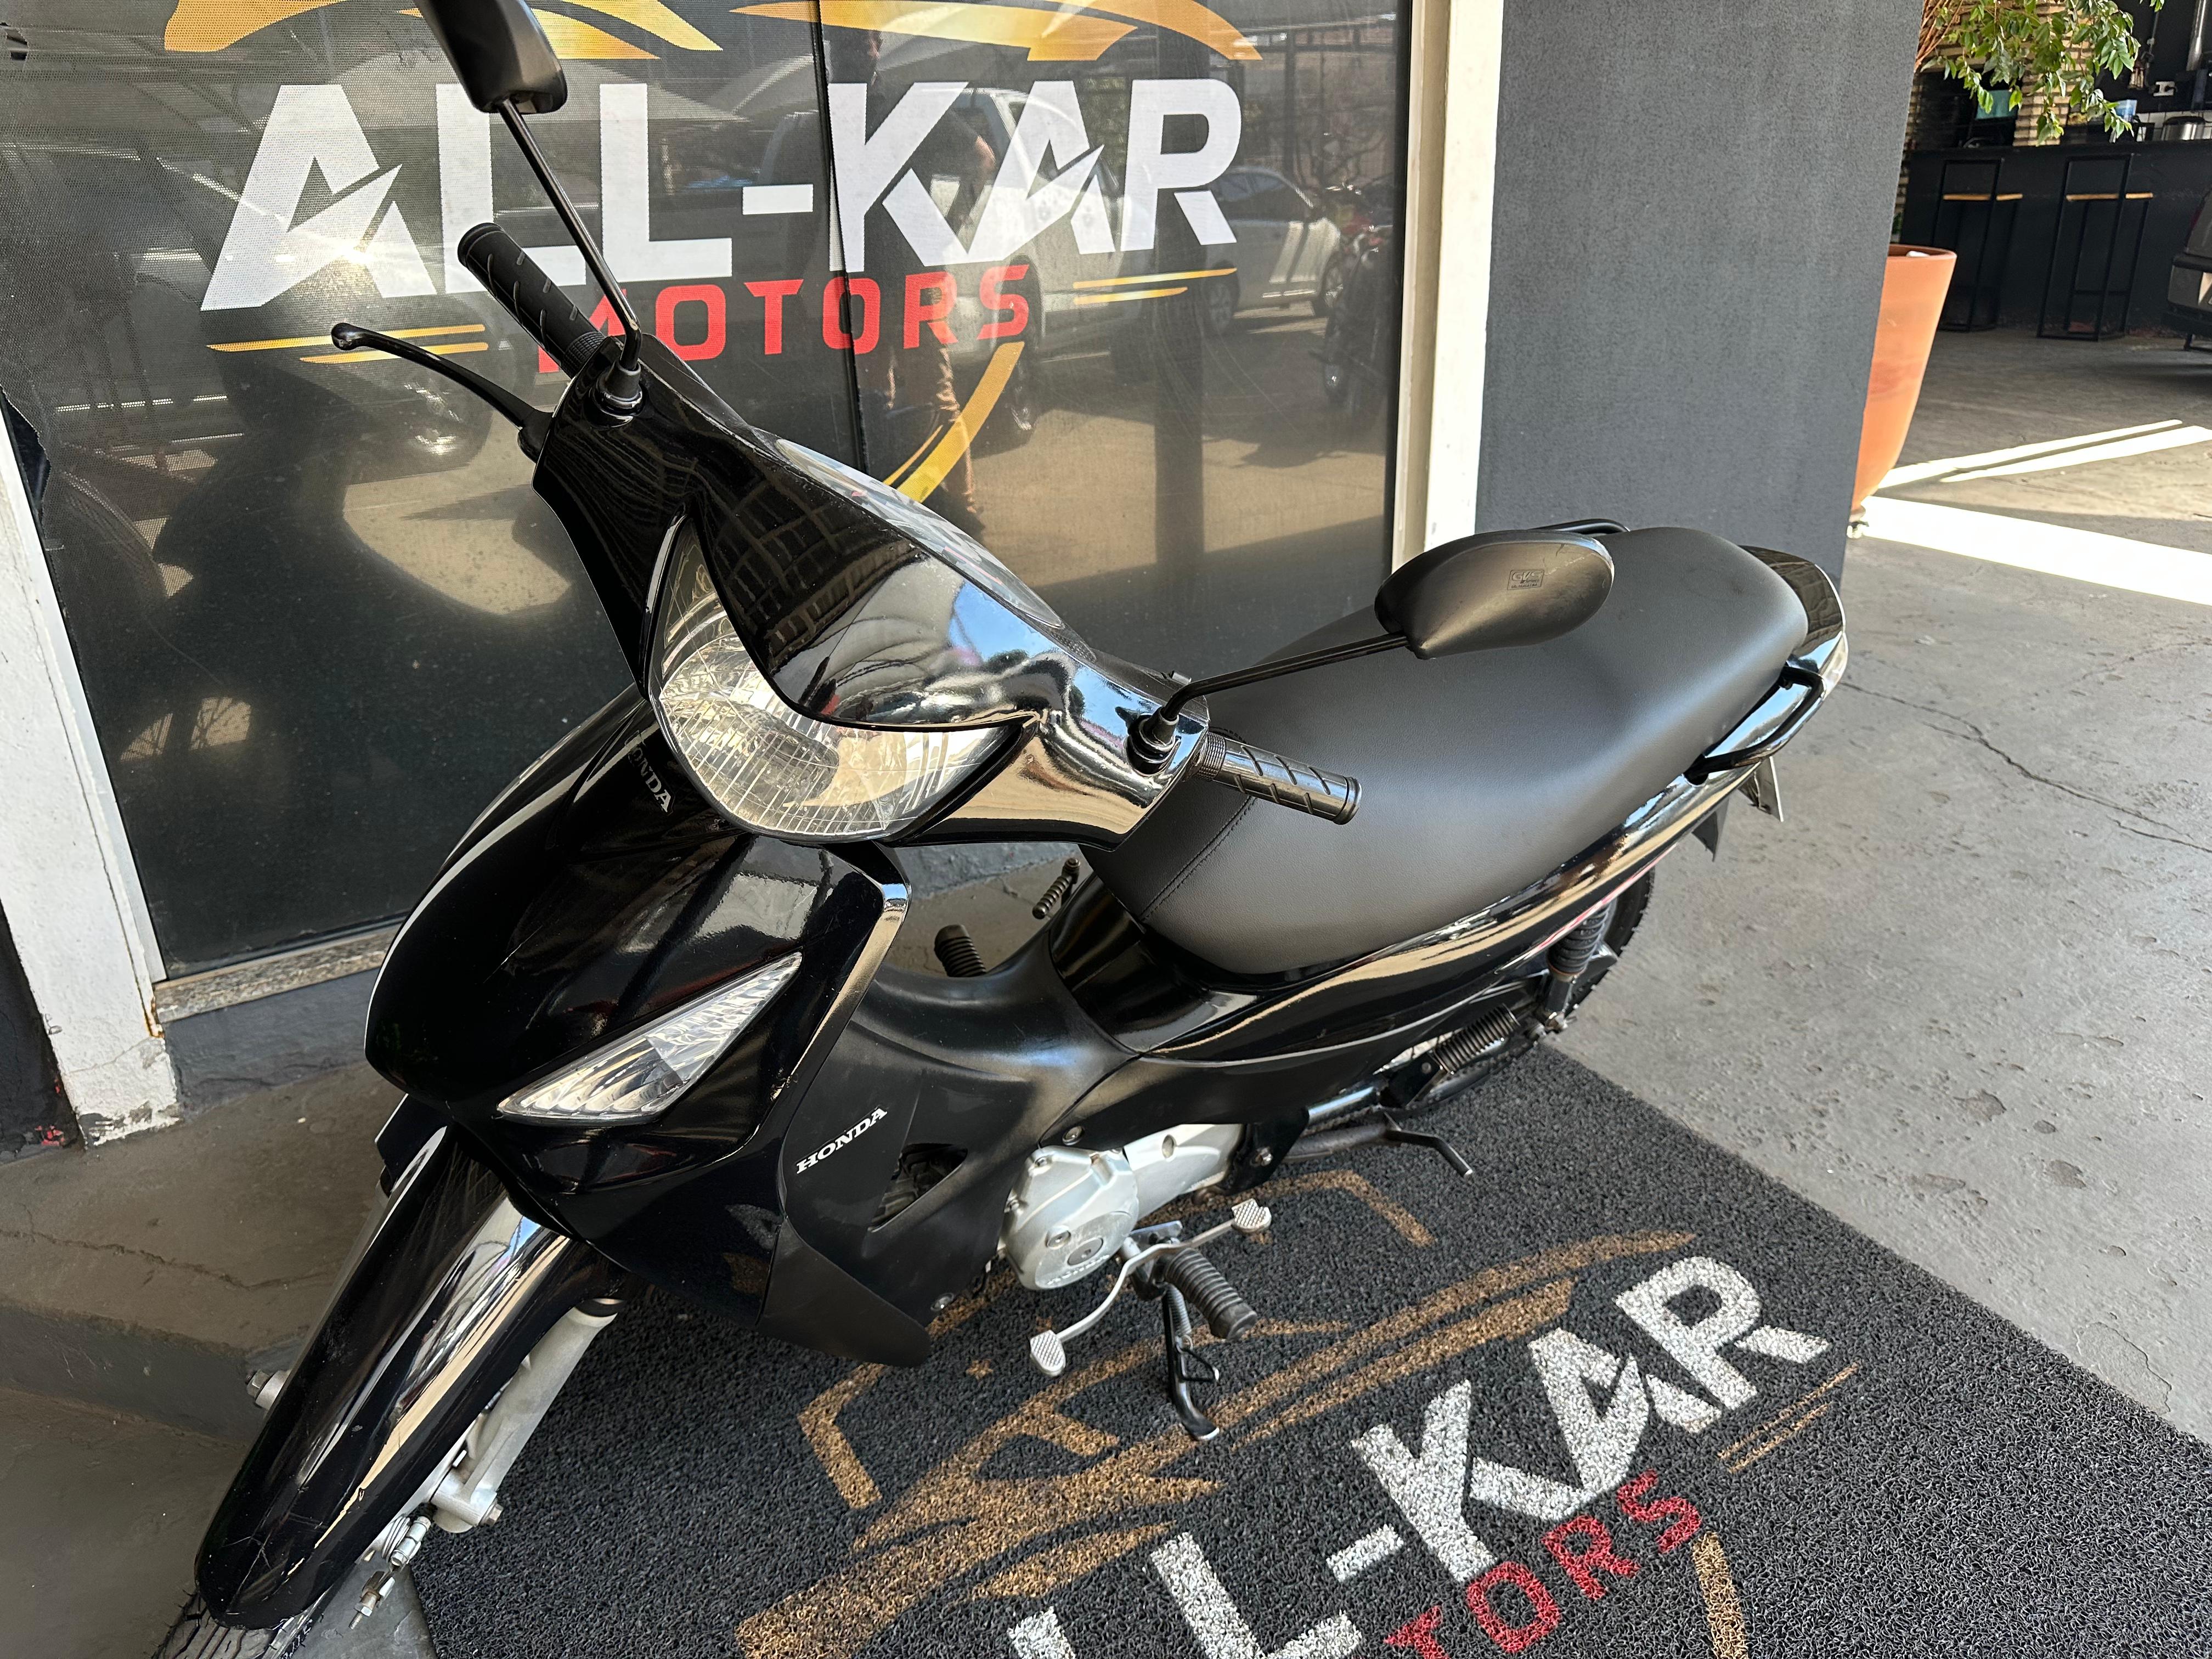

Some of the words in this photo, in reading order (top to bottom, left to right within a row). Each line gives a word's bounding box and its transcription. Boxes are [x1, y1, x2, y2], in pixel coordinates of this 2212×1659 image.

[201, 78, 1242, 311] ALL-KAR
[629, 744, 672, 813] ONDA
[797, 1108, 888, 1174] HONDA
